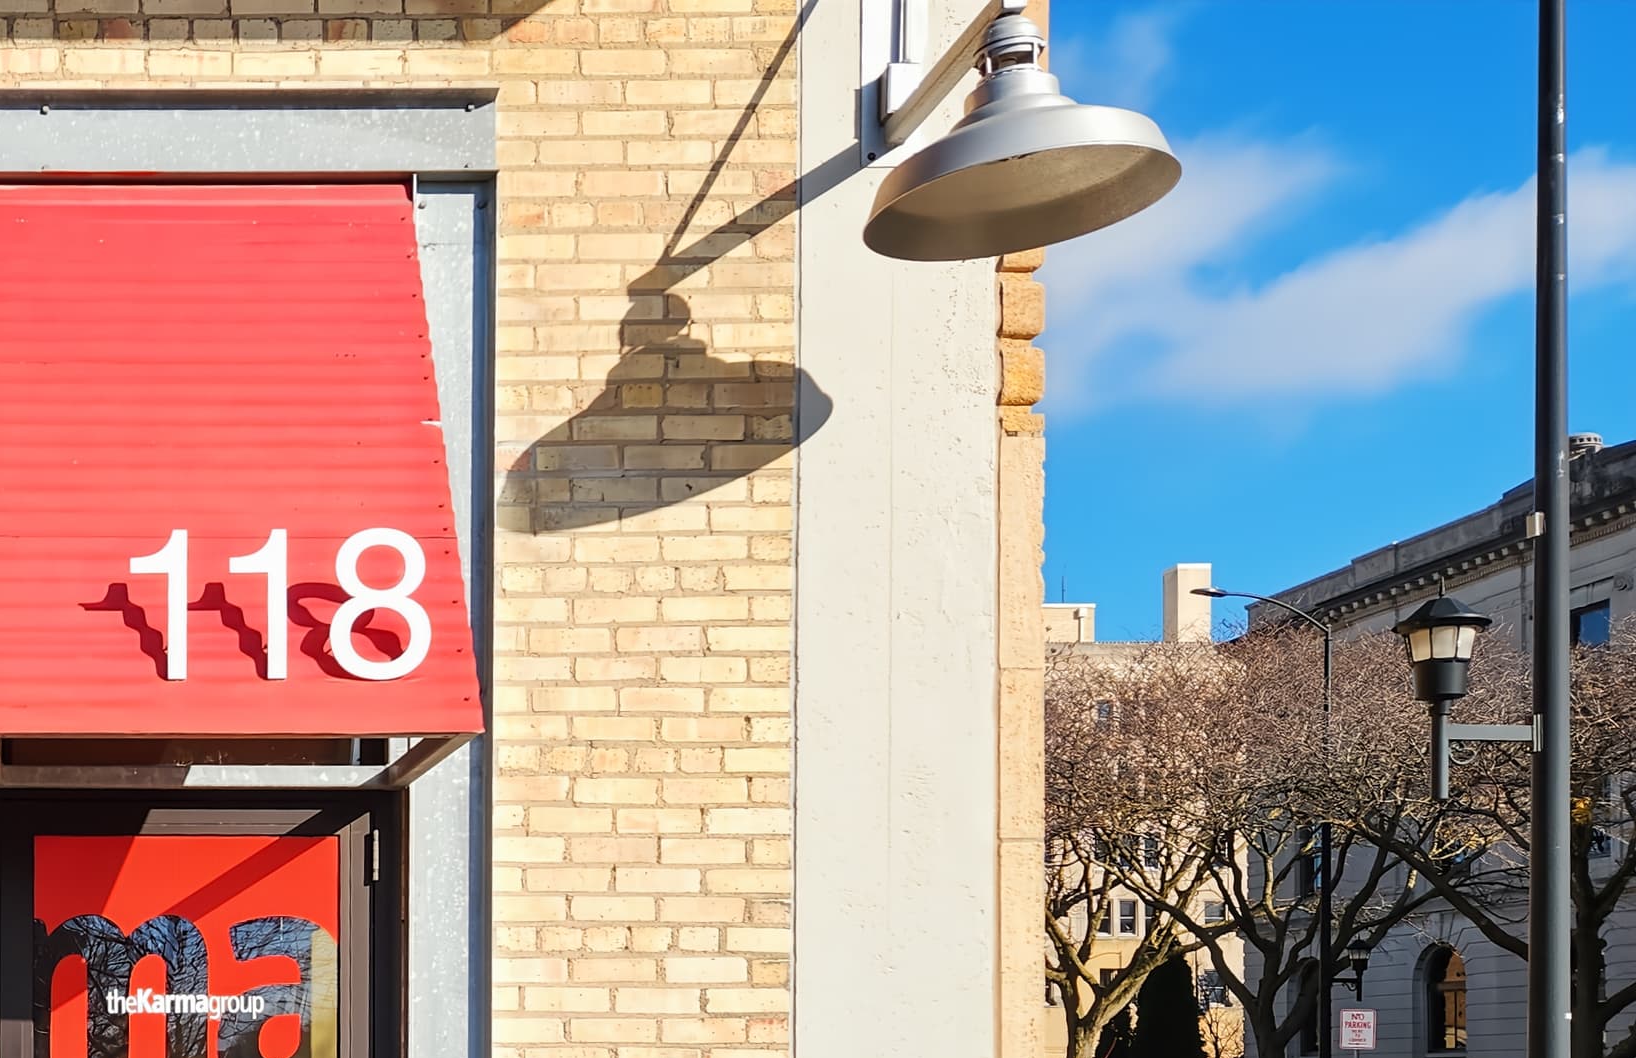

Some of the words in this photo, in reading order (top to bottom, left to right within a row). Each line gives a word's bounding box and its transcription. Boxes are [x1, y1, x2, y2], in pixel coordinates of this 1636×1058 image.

[129, 527, 432, 681] 118
[1351, 1013, 1365, 1021] NO
[1344, 1021, 1373, 1029] PARKING
